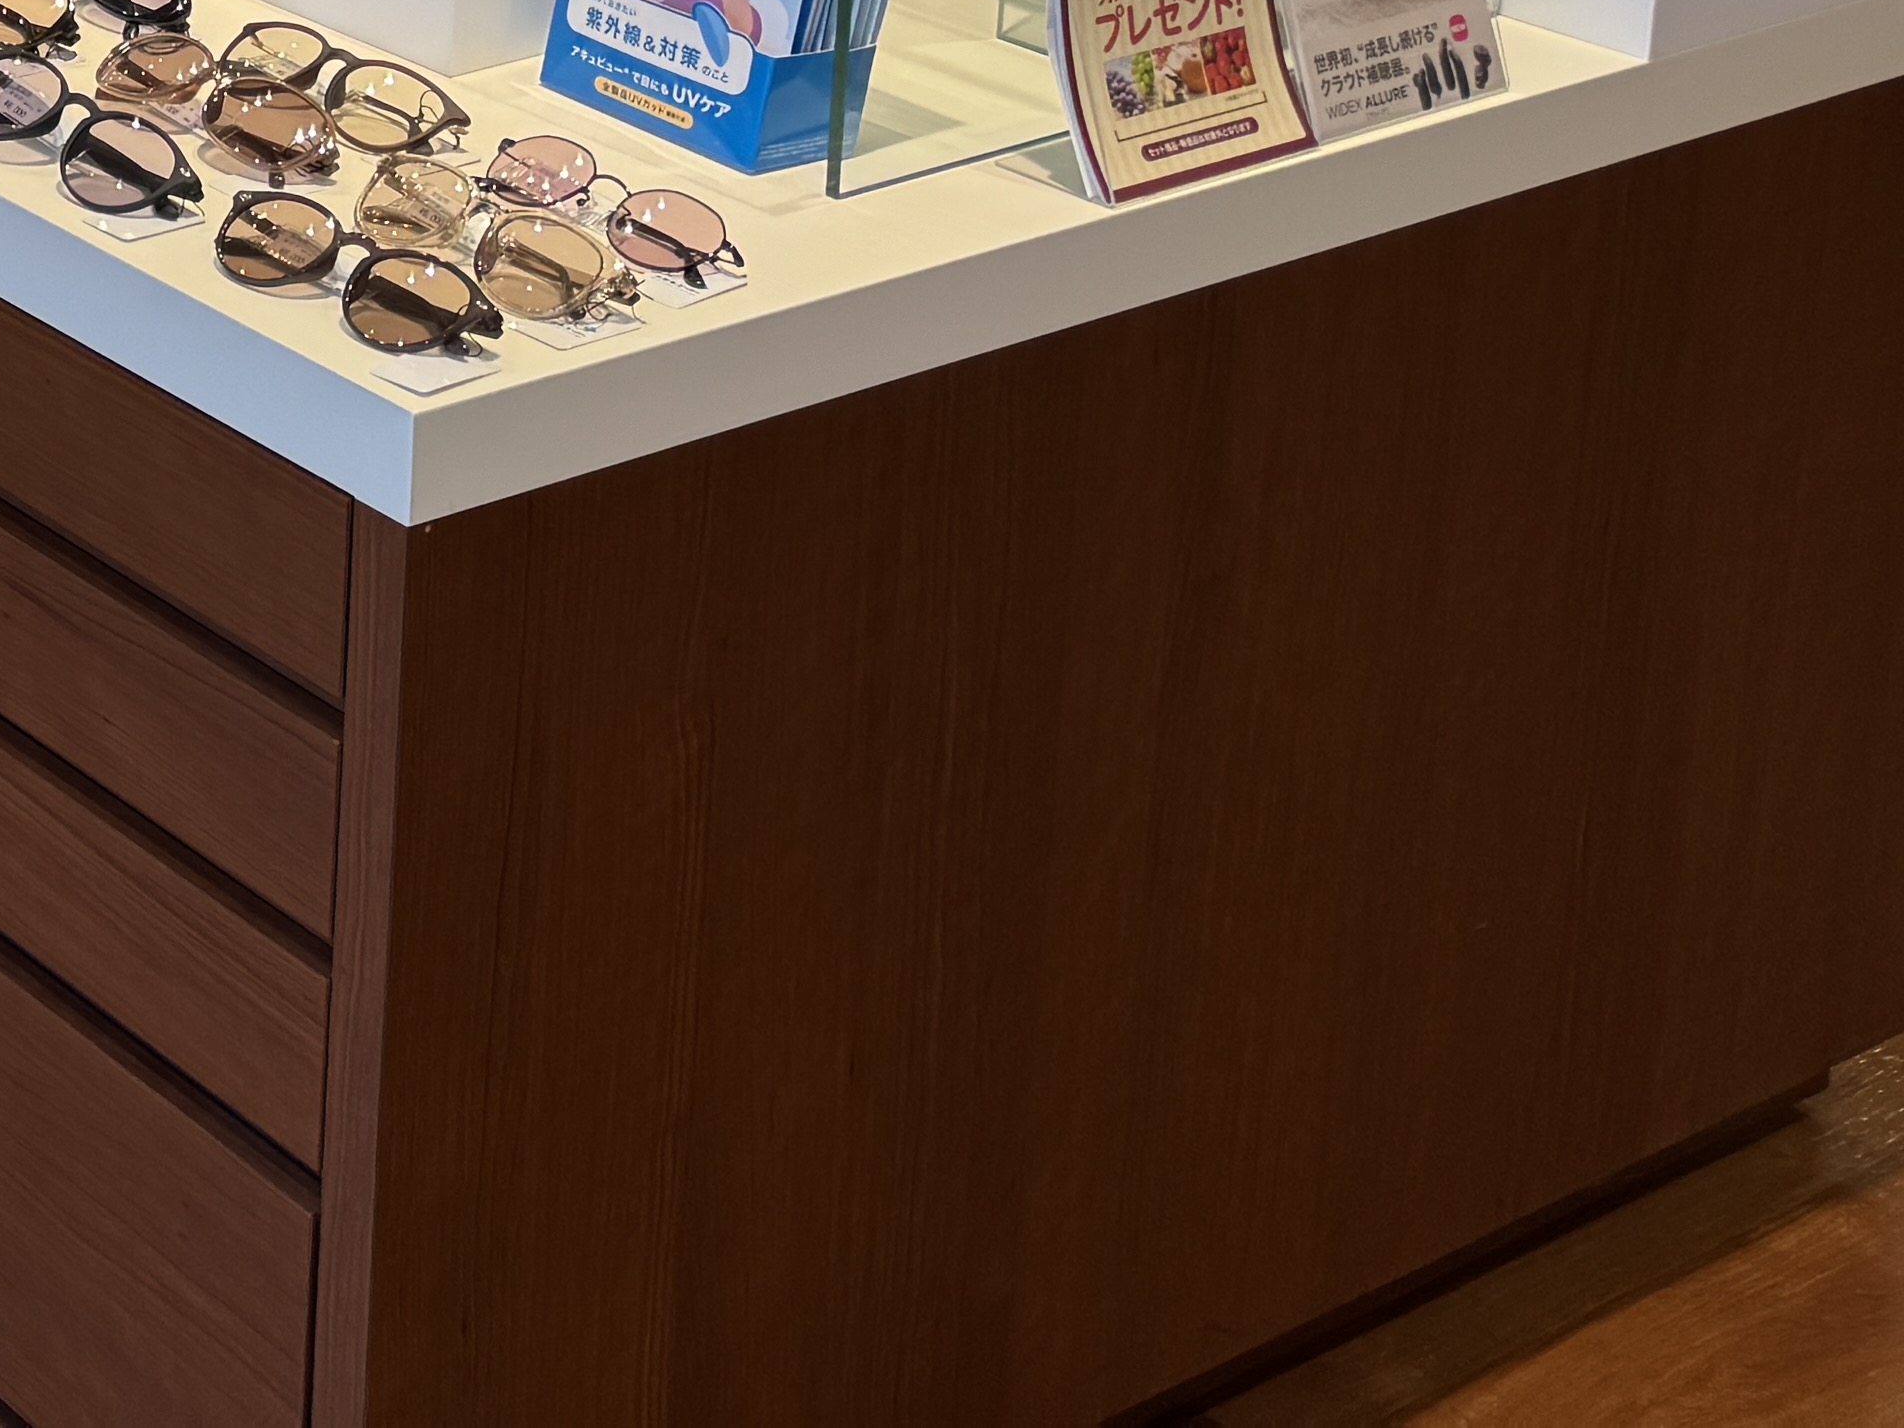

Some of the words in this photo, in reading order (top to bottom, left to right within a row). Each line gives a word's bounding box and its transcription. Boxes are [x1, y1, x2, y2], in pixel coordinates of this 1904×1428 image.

[1320, 57, 1411, 98] クラウド補聴器。
[1325, 97, 1364, 121] WIDEX
[1364, 86, 1409, 109] ALLURE
